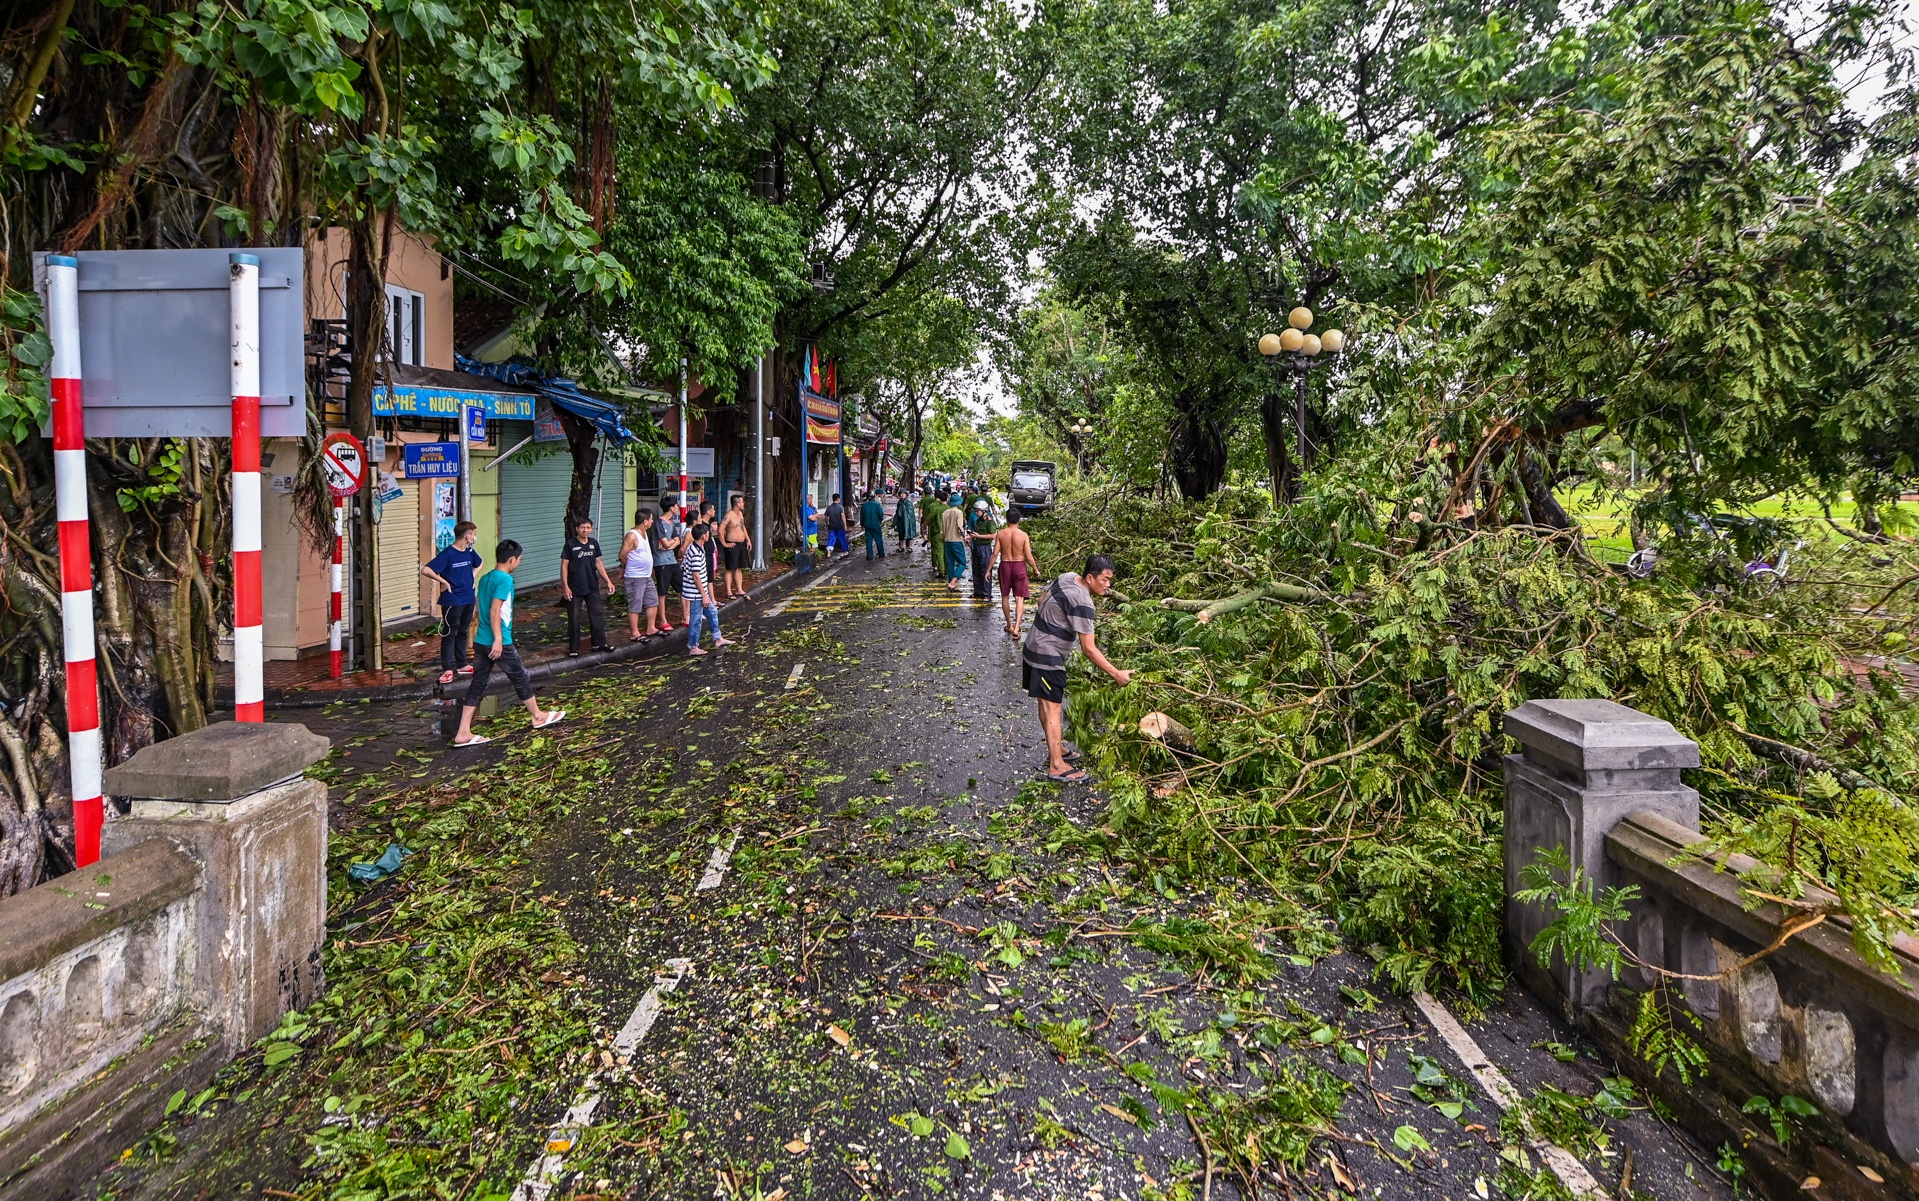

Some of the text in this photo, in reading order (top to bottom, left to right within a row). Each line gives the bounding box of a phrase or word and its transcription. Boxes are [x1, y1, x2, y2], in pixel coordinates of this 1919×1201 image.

[494, 401, 518, 415] SINH
[519, 398, 531, 415] TỐ
[408, 460, 458, 474] TRẦN HUY LIỆU
